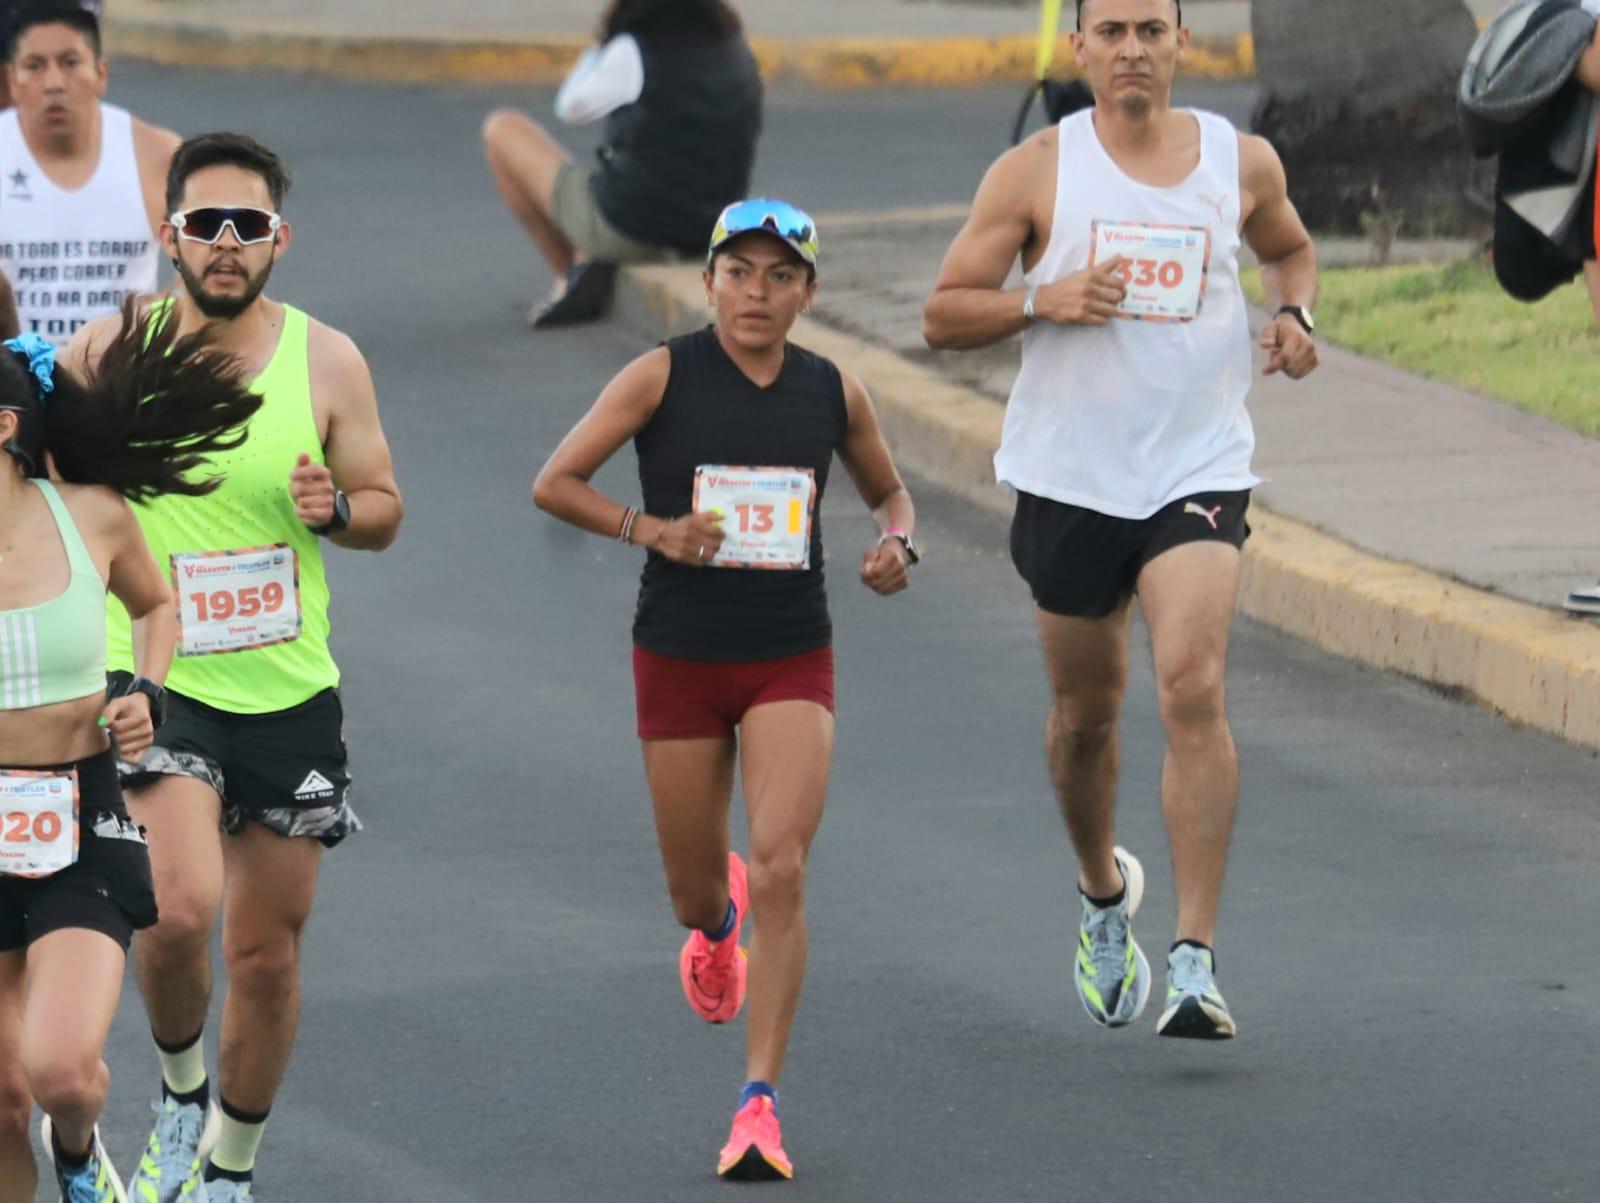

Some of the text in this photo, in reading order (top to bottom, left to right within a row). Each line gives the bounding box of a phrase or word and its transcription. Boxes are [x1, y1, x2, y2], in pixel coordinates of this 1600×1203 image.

[18, 243, 59, 258] TODO
[64, 242, 82, 257] ES
[19, 266, 58, 282] PERO
[1116, 258, 1184, 288] 330
[57, 291, 81, 306] HA
[735, 504, 774, 533] 13
[190, 582, 284, 622] 1959
[0, 811, 63, 842] 20
